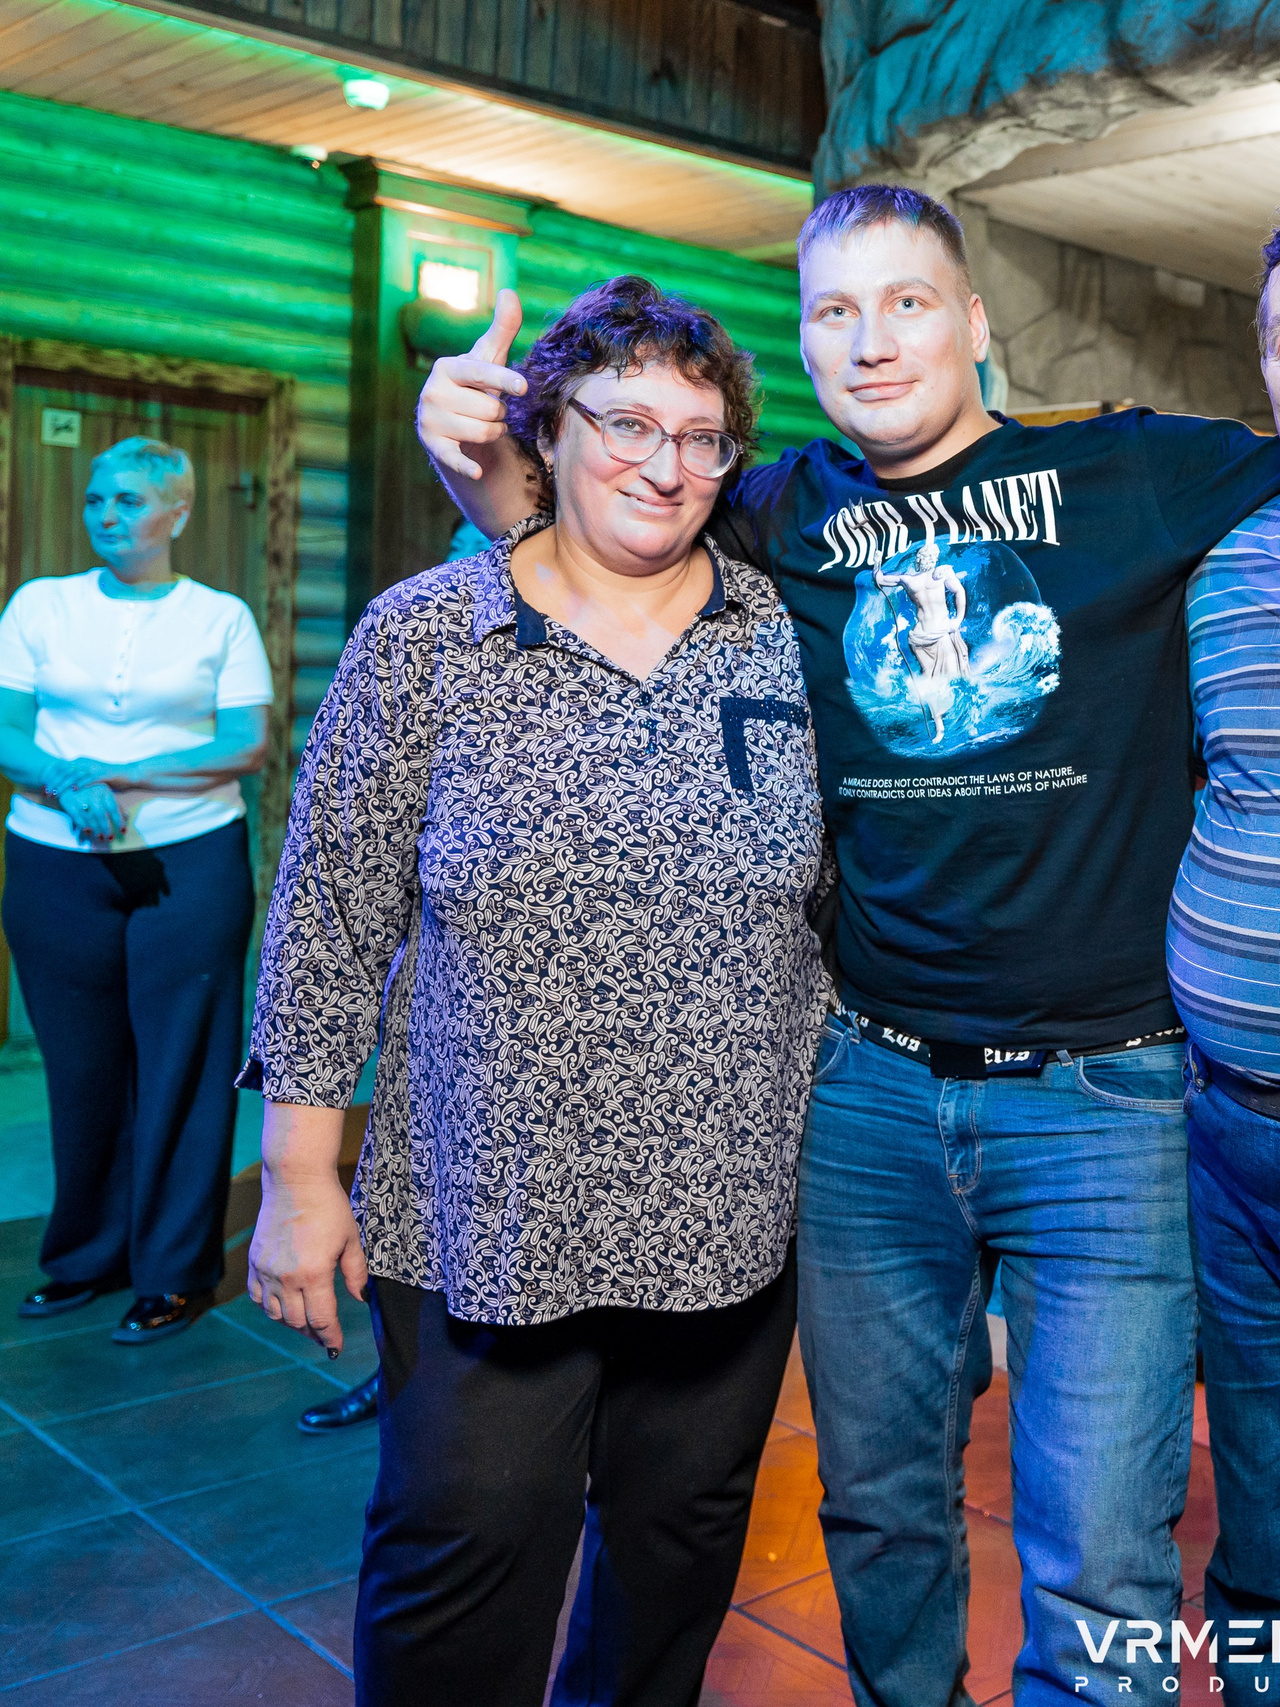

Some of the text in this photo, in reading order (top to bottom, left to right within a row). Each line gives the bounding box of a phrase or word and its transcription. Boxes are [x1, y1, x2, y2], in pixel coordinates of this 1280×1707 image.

[905, 469, 1062, 546] PLANET
[848, 777, 872, 787] MIRACLE
[872, 779, 892, 788] DOES
[895, 778, 911, 788] NOT
[912, 776, 968, 787] CONTRADICT
[970, 775, 985, 785] THE
[987, 773, 1015, 784] LAWS
[1018, 771, 1032, 781] OF
[856, 789, 905, 799] CONTRADICTS
[907, 789, 925, 798] OUR
[928, 788, 952, 798] IDEAS
[954, 786, 981, 797] ABOUT
[984, 785, 1001, 795] THE
[1004, 783, 1032, 794] LAWS
[1035, 781, 1049, 791] OF
[1052, 774, 1088, 789] NATURE
